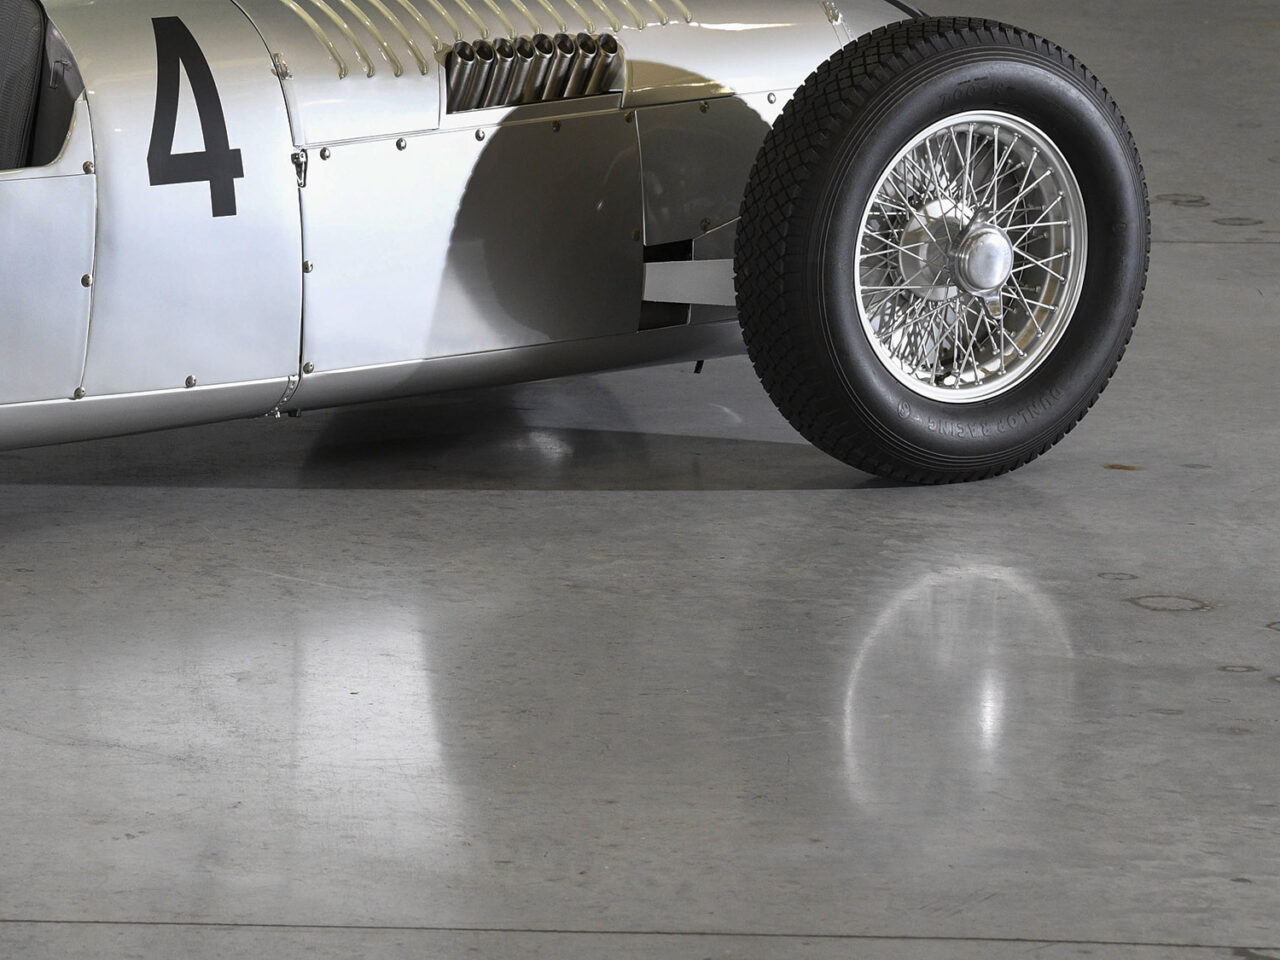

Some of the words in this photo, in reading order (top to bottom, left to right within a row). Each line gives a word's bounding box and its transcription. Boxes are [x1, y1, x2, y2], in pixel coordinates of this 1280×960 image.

[147, 16, 245, 218] 4
[928, 417, 991, 439] RACING
[997, 387, 1065, 432] DUNLOP
